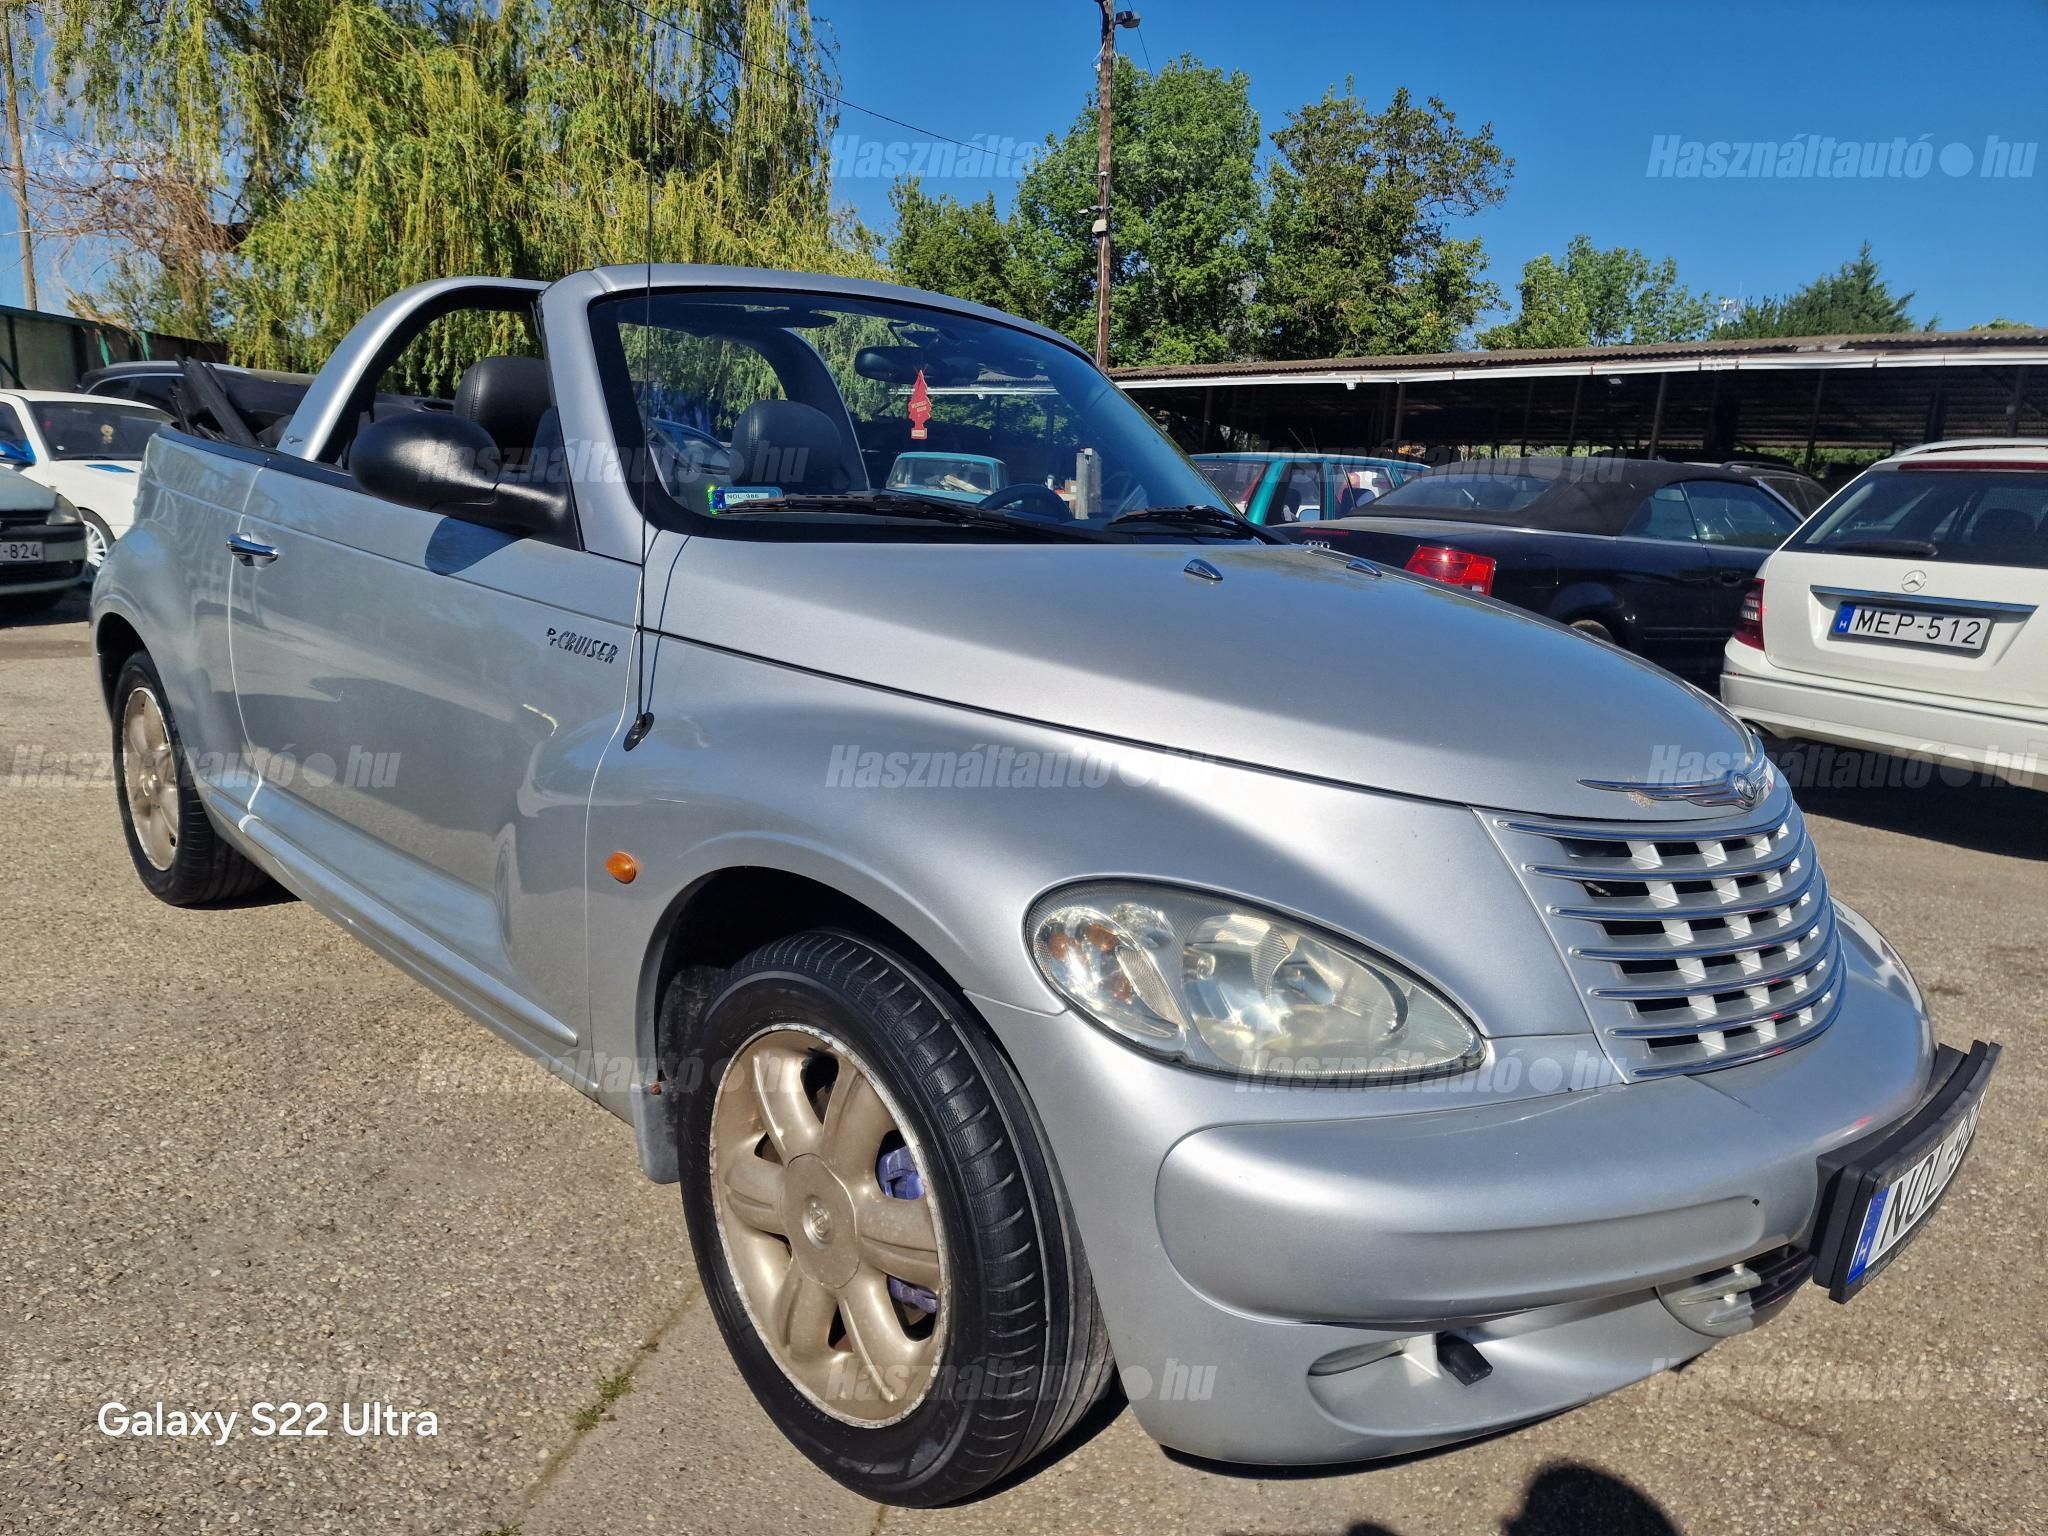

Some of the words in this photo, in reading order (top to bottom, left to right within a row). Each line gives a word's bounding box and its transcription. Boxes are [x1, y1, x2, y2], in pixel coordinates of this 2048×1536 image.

[0, 544, 40, 559] -824
[1855, 608, 1982, 645] MEP-512
[557, 630, 619, 664] CRUISER
